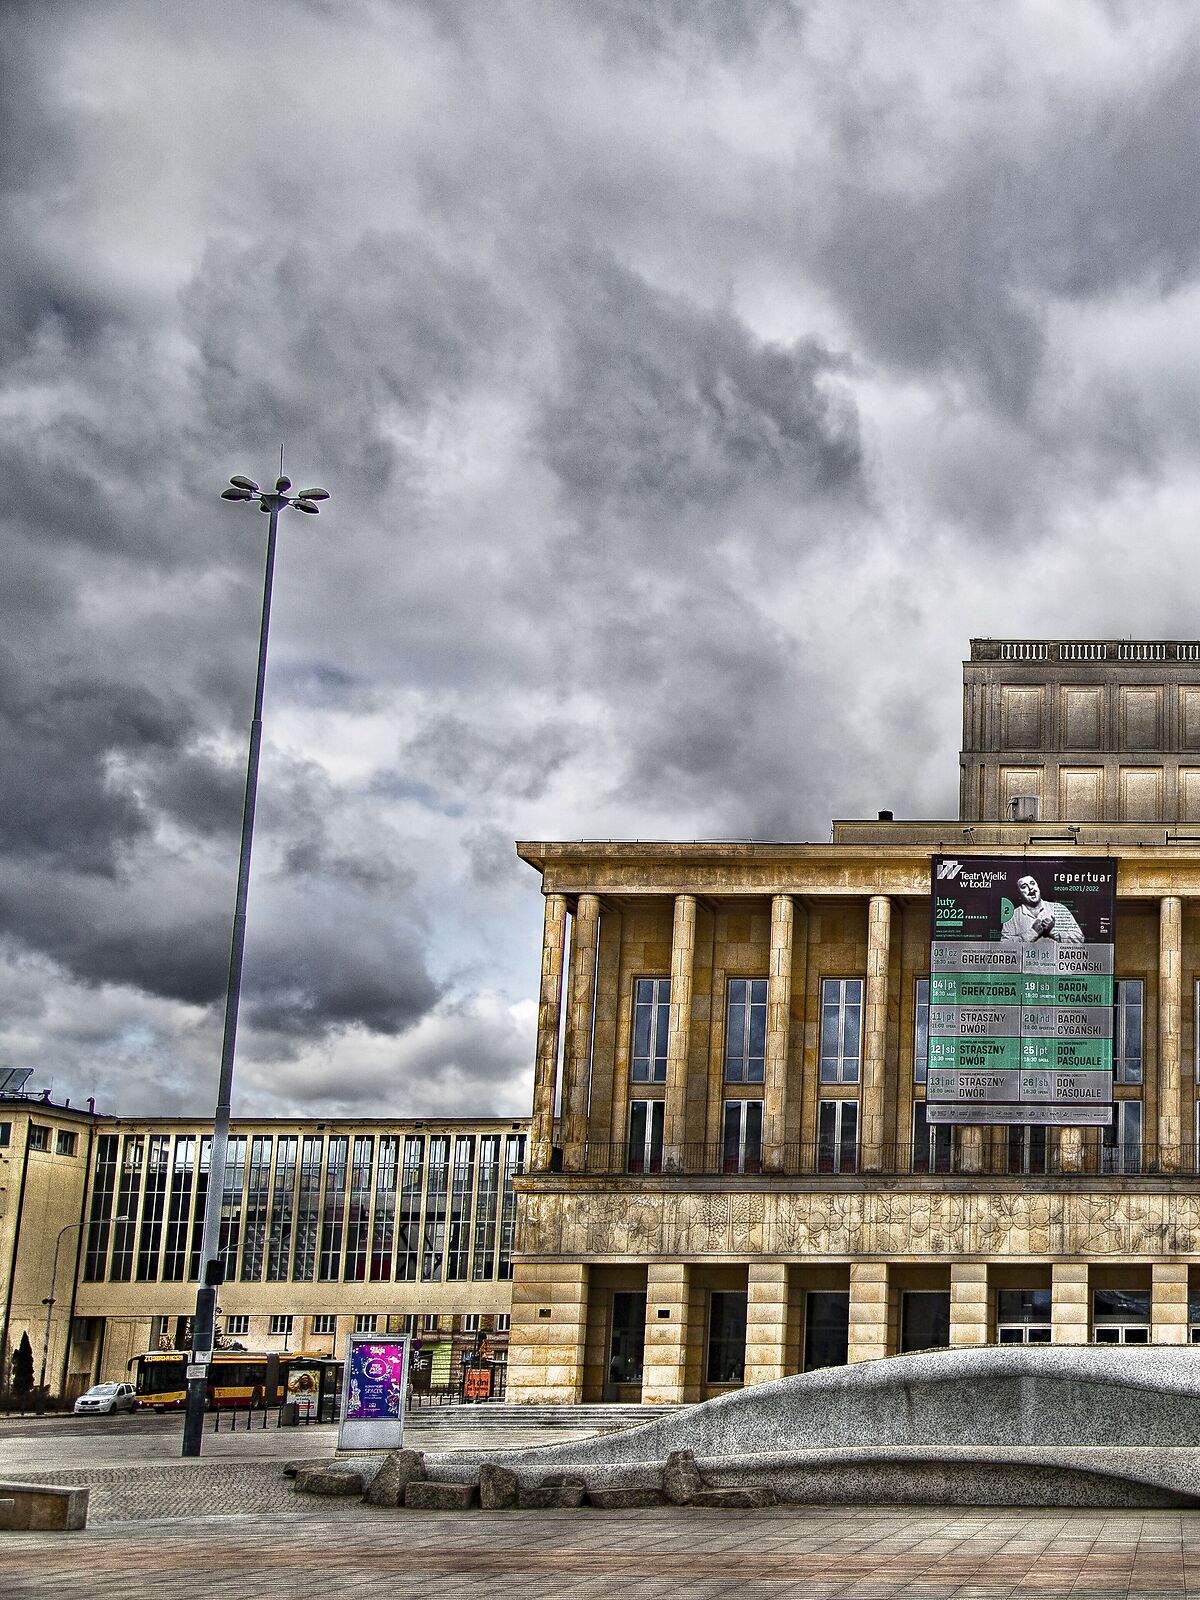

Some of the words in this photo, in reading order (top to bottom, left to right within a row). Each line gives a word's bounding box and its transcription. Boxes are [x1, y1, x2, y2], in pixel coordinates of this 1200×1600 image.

[960, 871, 980, 880] Teatr
[980, 871, 1007, 880] Wielki
[1054, 872, 1111, 884] repertuar
[969, 880, 991, 888] Łodzi
[936, 897, 955, 907] luty
[936, 909, 964, 918] 2022
[962, 954, 986, 964] GREK
[986, 955, 1017, 964] ZORBA
[1026, 950, 1036, 958] 18
[1042, 951, 1049, 960] pt
[1059, 950, 1088, 960] BARON
[1058, 960, 1102, 971] CYGAŃSKI
[933, 980, 942, 988] 04
[948, 980, 956, 990] pt
[1024, 982, 1036, 990] 19
[1040, 982, 1050, 990] sb
[1058, 982, 1088, 991] BARON
[962, 986, 986, 996] GREK
[986, 986, 1016, 996] ZORBA
[1058, 992, 1102, 1002] CYGAŃSKI
[932, 1012, 941, 1020] 11
[946, 1012, 954, 1022] pt
[960, 1014, 1006, 1022] STRASZNY
[1058, 1014, 1088, 1023] BARON
[960, 1022, 986, 1033] DWÓR
[1057, 1024, 1100, 1034] CYGAŃSKI
[931, 1045, 940, 1054] 12
[946, 1045, 956, 1054] sb
[960, 1046, 1005, 1054] STRASZNY
[1024, 1046, 1034, 1054] 25
[1040, 1046, 1048, 1056] pt
[1058, 1047, 1076, 1055] DON
[960, 1054, 985, 1065] DWÓR
[1057, 1056, 1102, 1066] PASQUALE
[960, 1078, 1004, 1086] STRASZNY
[1023, 1078, 1034, 1086] 26
[1038, 1078, 1048, 1086] sb
[1057, 1079, 1074, 1087] DON
[959, 1087, 984, 1097] DWÓR
[1056, 1089, 1101, 1098] PASQUALE
